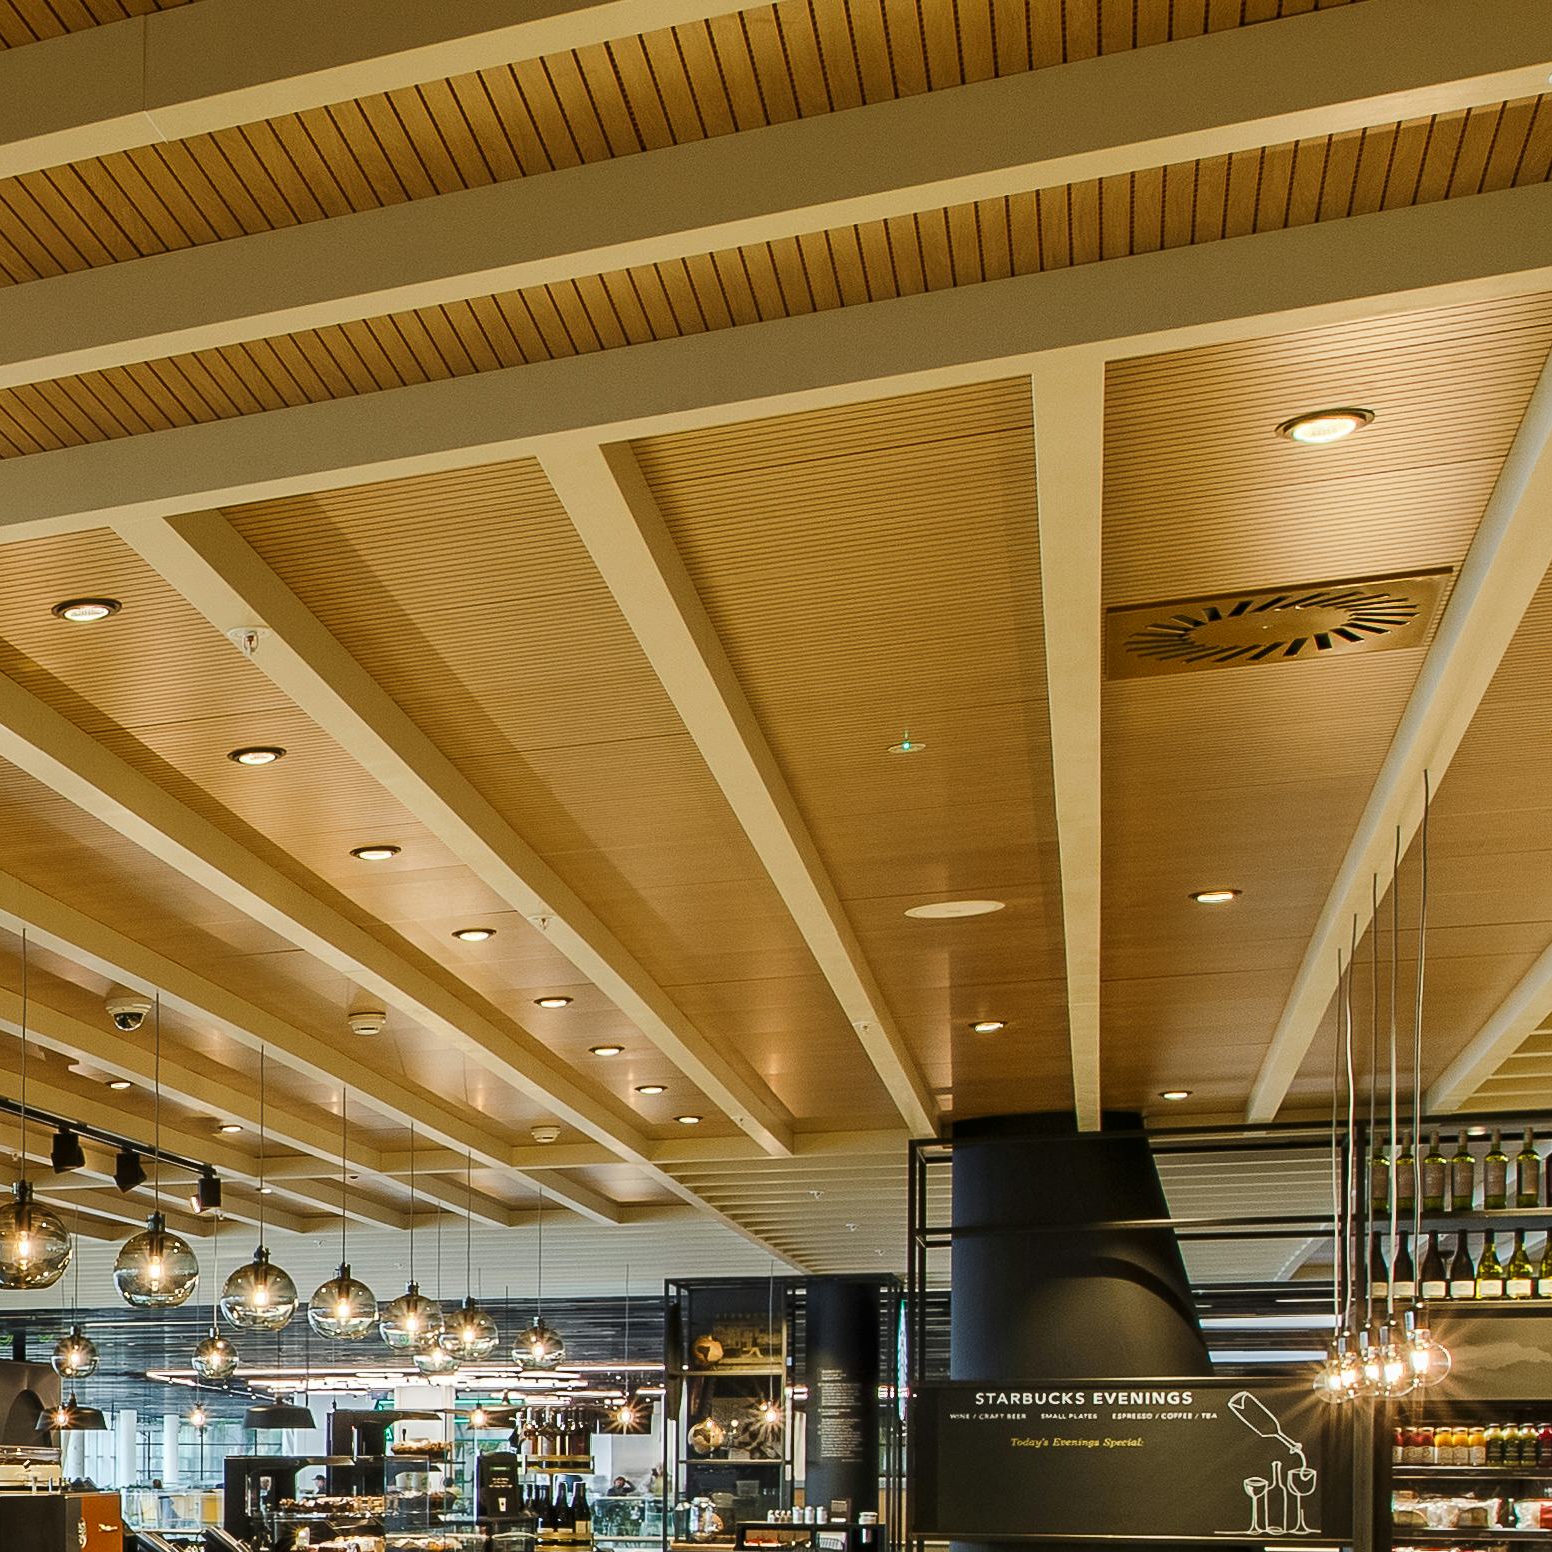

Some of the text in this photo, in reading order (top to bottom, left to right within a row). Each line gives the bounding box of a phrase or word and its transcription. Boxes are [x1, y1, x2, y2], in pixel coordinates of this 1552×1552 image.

[975, 1391, 1193, 1405] STARBUCKS EVENINGS
[1112, 1412, 1153, 1420] ESPRESSO
[1160, 1412, 1193, 1420] COFFEE
[1010, 1437, 1049, 1448] Today's
[1052, 1437, 1100, 1448] Evenings
